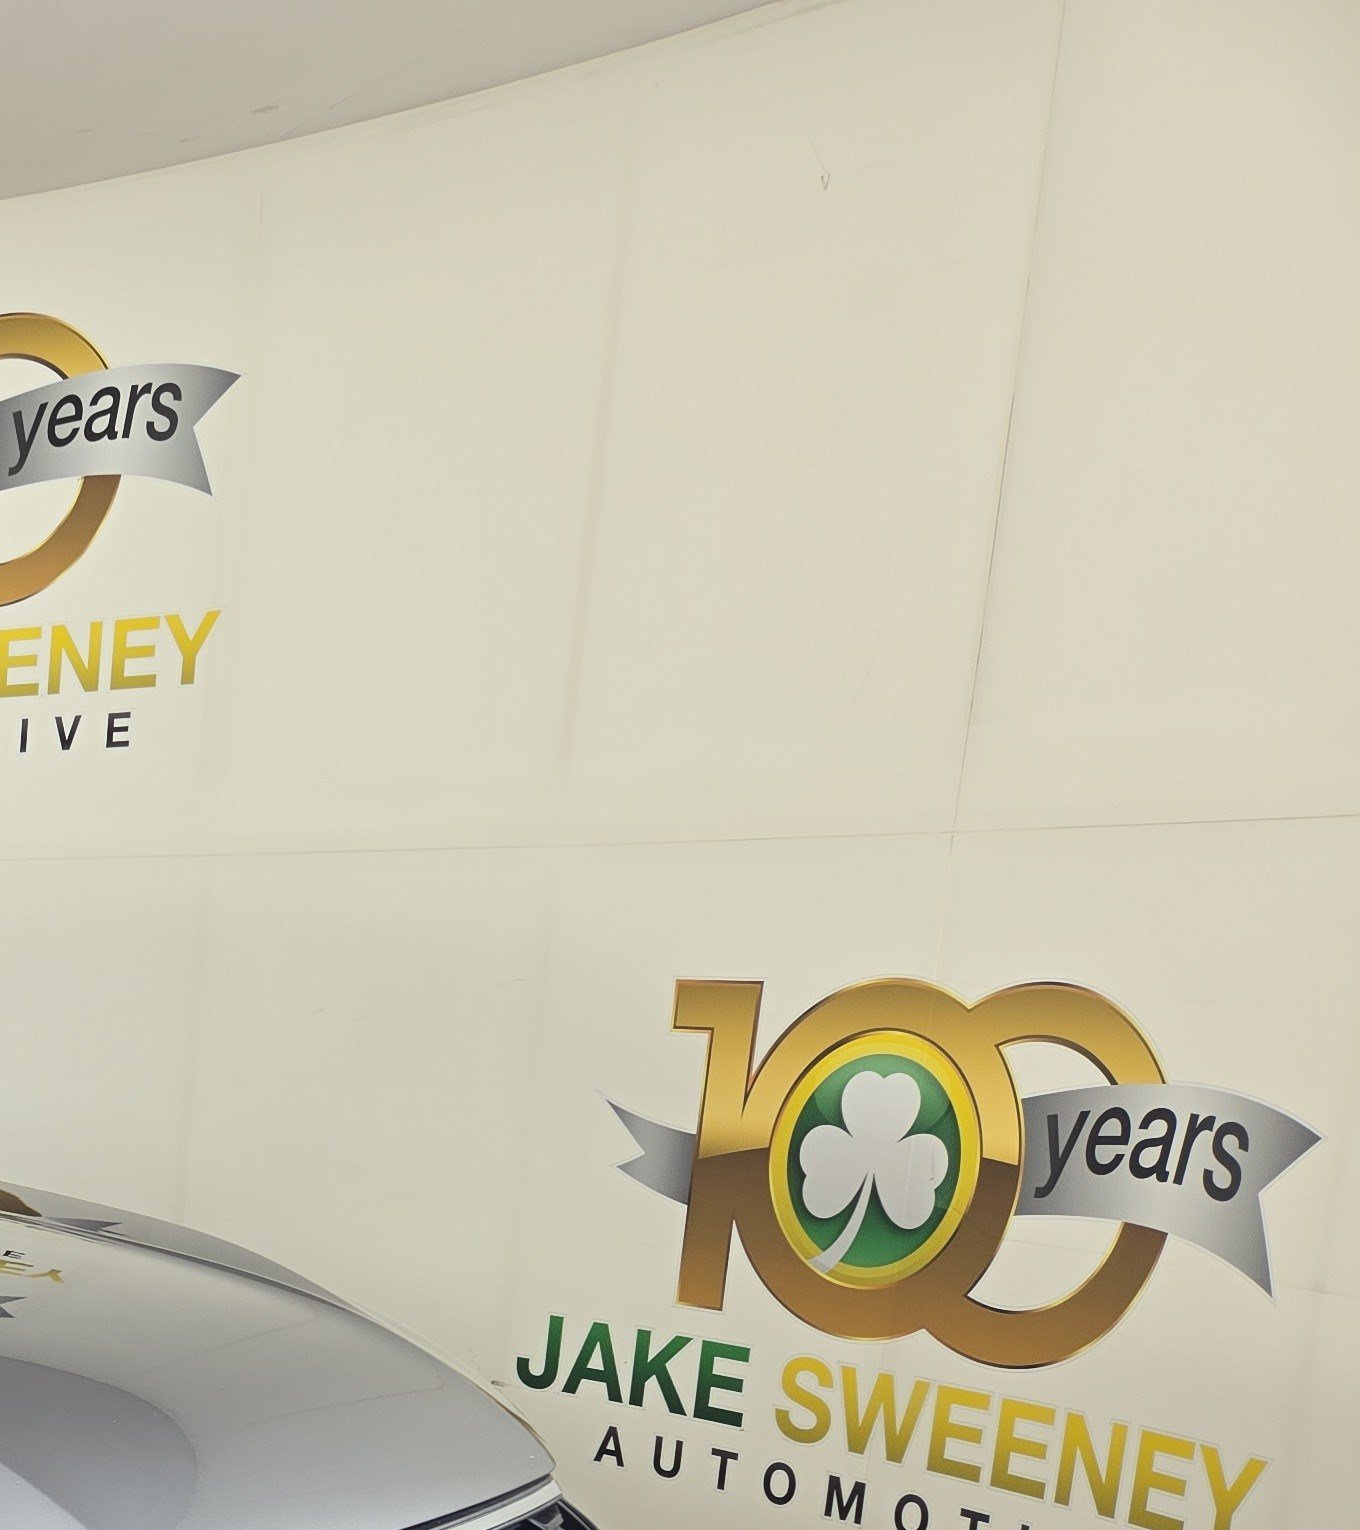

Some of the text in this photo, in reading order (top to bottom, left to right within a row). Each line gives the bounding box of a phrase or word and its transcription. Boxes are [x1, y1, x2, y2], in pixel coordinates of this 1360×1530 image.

[8, 381, 182, 476] years
[1034, 1107, 1248, 1200] years
[516, 1314, 751, 1428] JAKE
